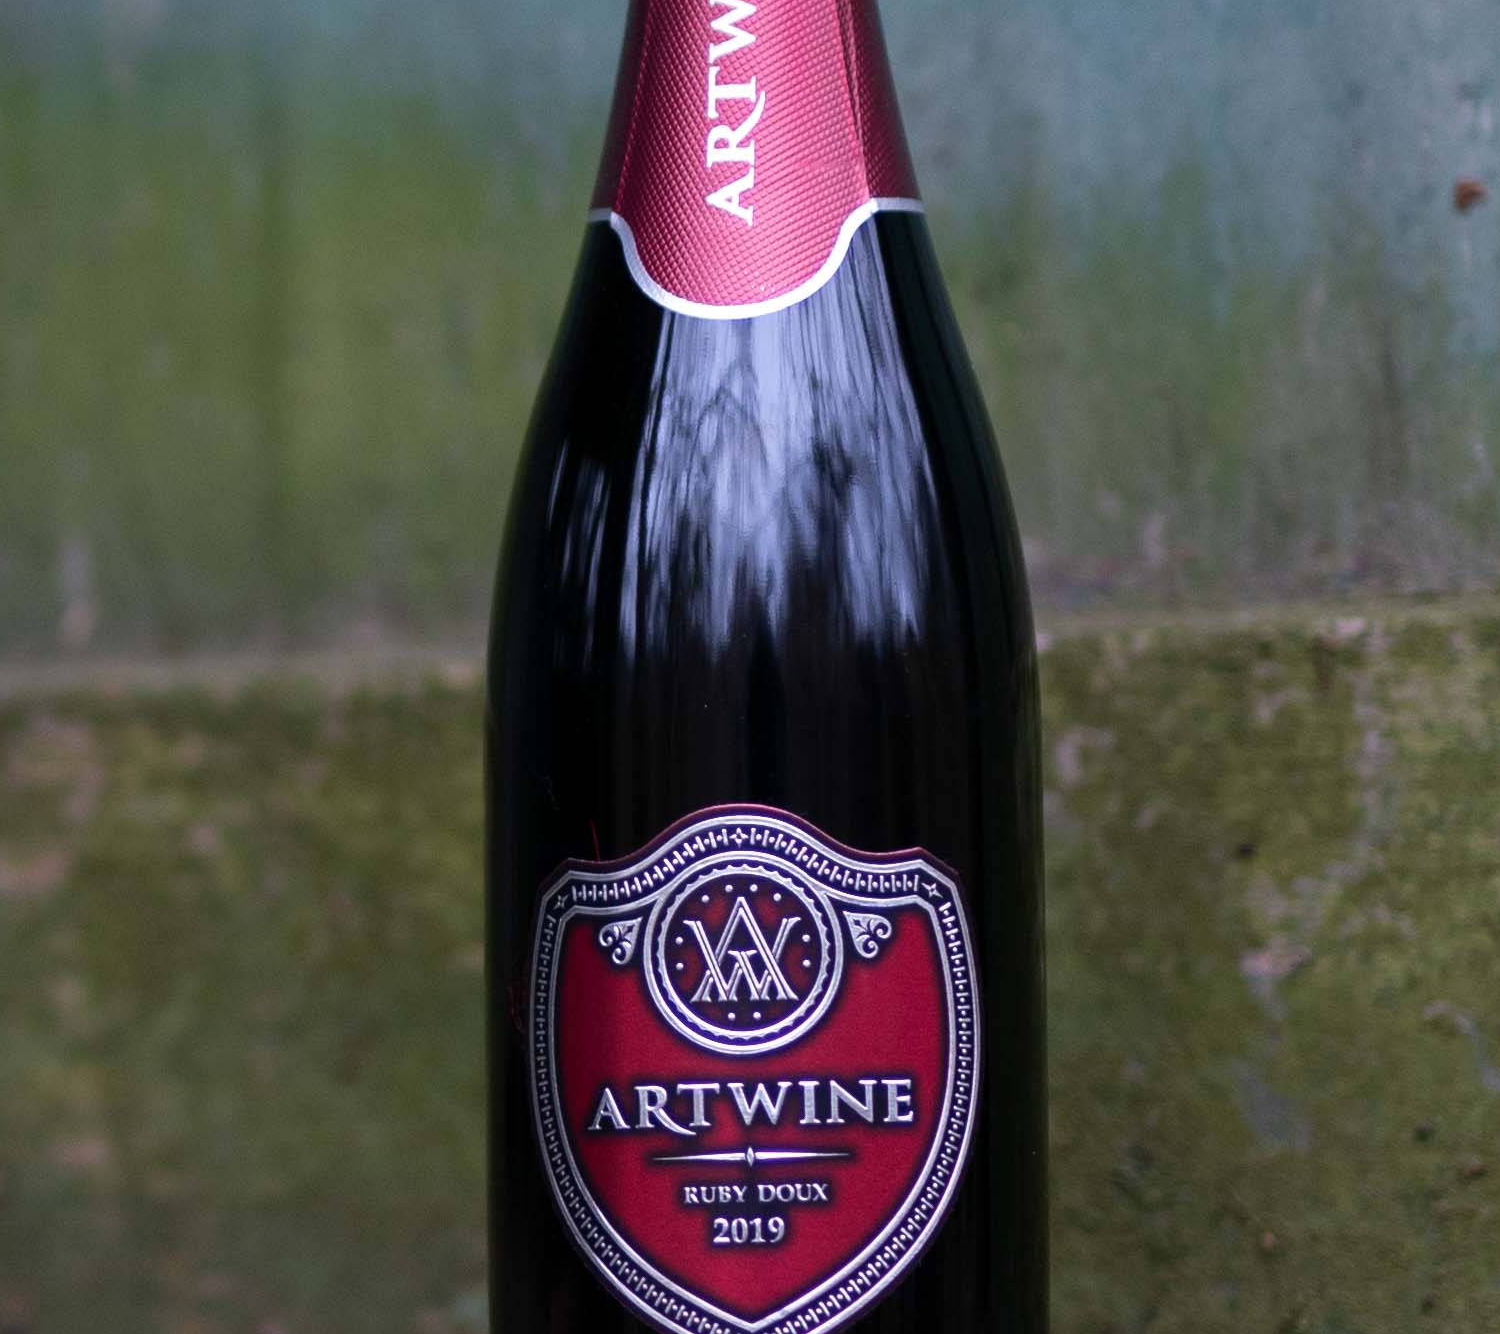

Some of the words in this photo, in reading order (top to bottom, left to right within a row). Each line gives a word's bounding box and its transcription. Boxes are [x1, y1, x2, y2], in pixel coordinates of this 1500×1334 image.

[588, 1078, 914, 1135] ARTWINE
[683, 1185, 747, 1204] RUBY
[758, 1183, 829, 1203] DOUX
[712, 1217, 785, 1244] 2019
